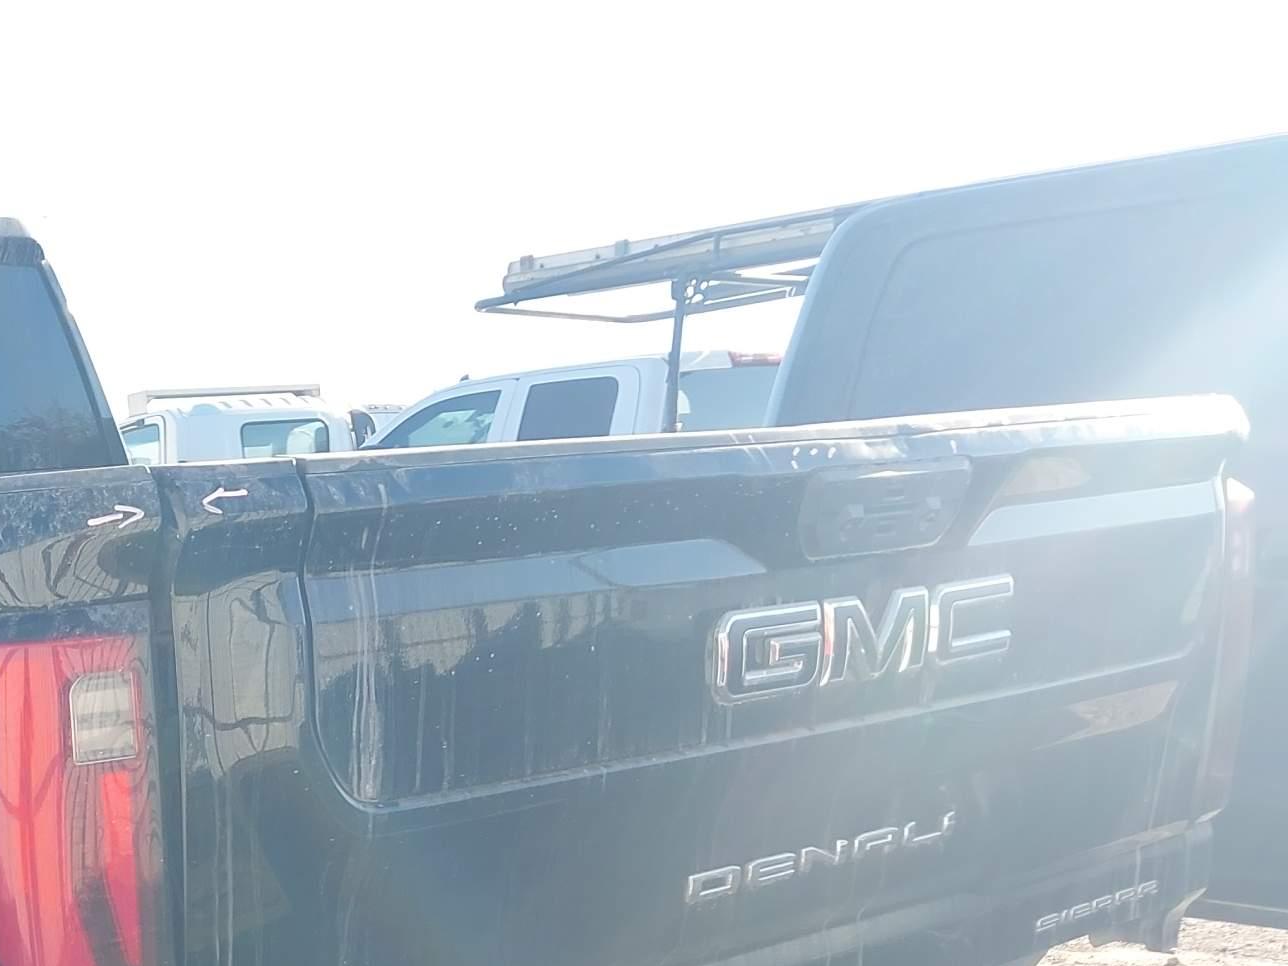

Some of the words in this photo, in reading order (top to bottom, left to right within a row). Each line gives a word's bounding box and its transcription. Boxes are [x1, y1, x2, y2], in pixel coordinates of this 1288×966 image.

[709, 573, 1014, 706] GMC
[685, 810, 956, 903] DENALI
[1034, 879, 1160, 933] SIERRA
